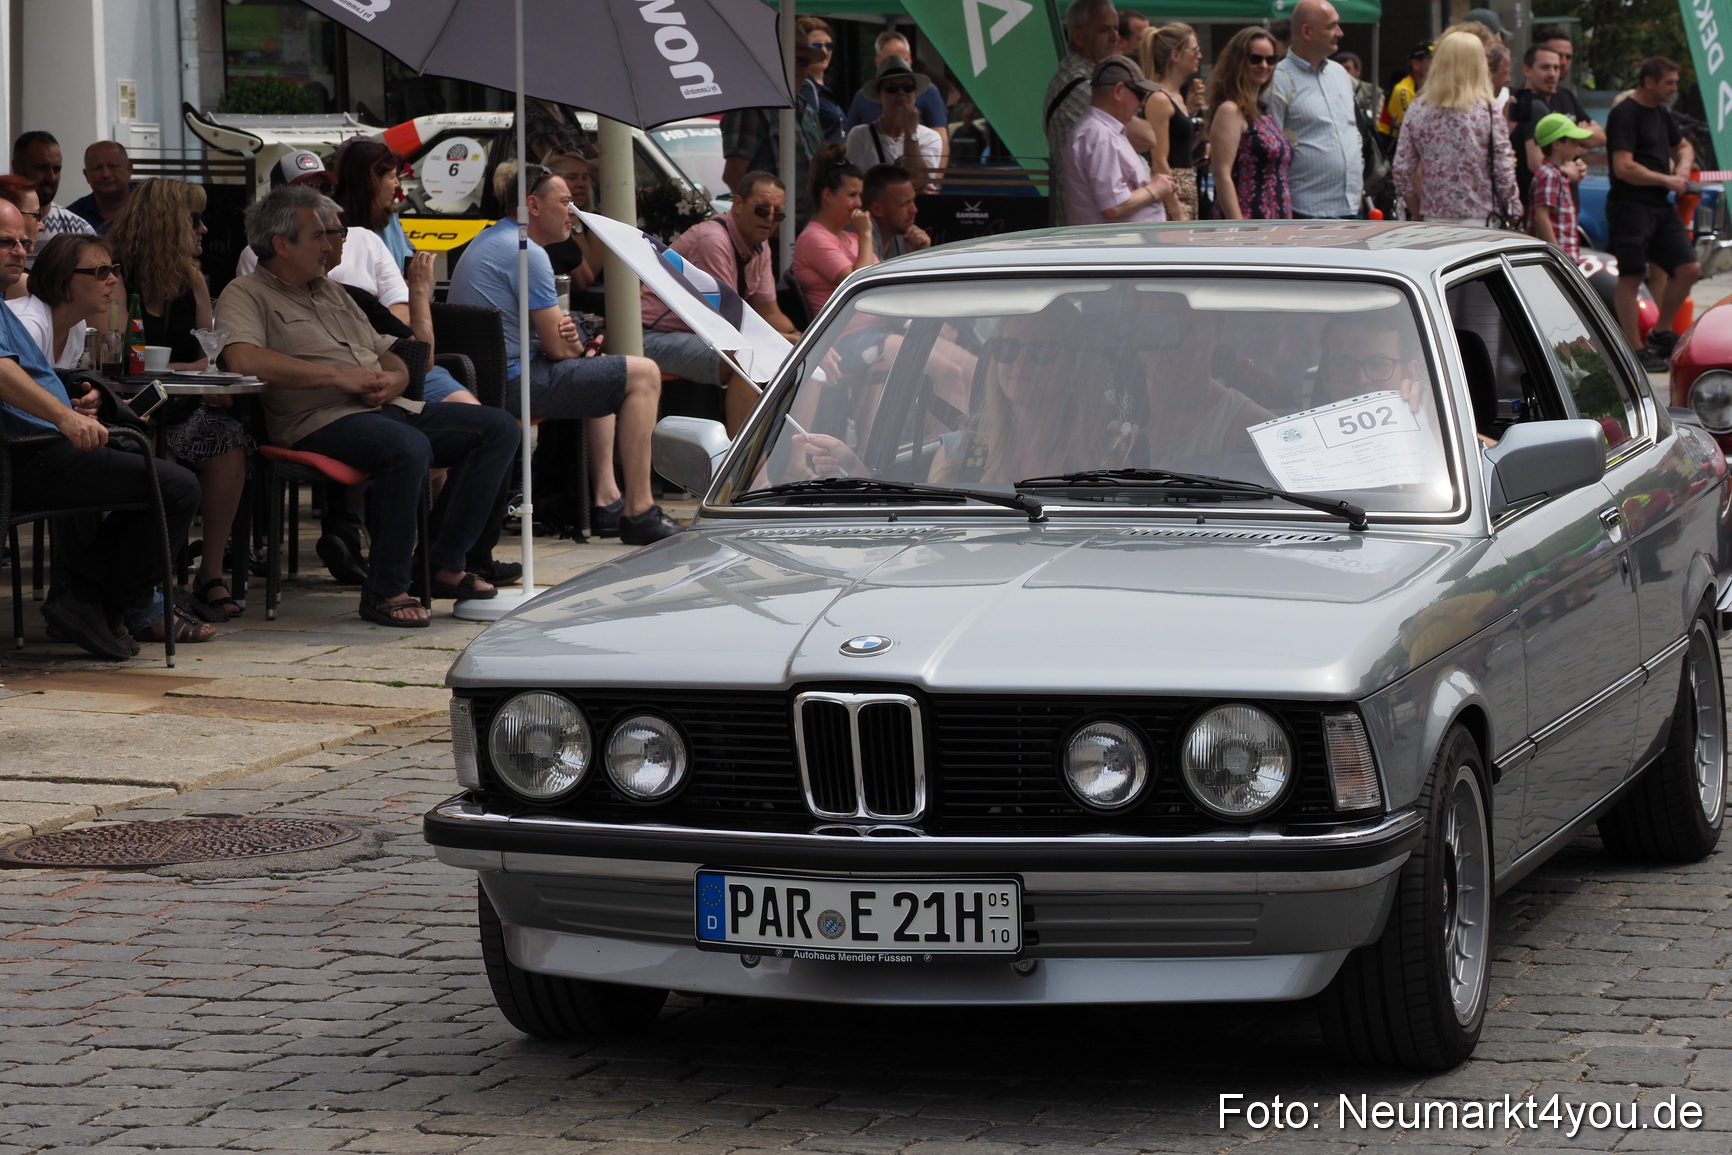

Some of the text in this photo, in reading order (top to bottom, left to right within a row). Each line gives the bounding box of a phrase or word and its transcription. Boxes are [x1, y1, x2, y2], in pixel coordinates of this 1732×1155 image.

[1692, 0, 1725, 76] DEK
[448, 163, 460, 177] 6
[1338, 406, 1399, 436] 502
[988, 892, 1010, 907] 05
[728, 883, 813, 939] PAR
[850, 890, 879, 942] E
[892, 891, 984, 943] 21H
[707, 915, 718, 930] D
[989, 928, 1010, 943] 10
[793, 949, 913, 963] Autohaus Mendler Füssen
